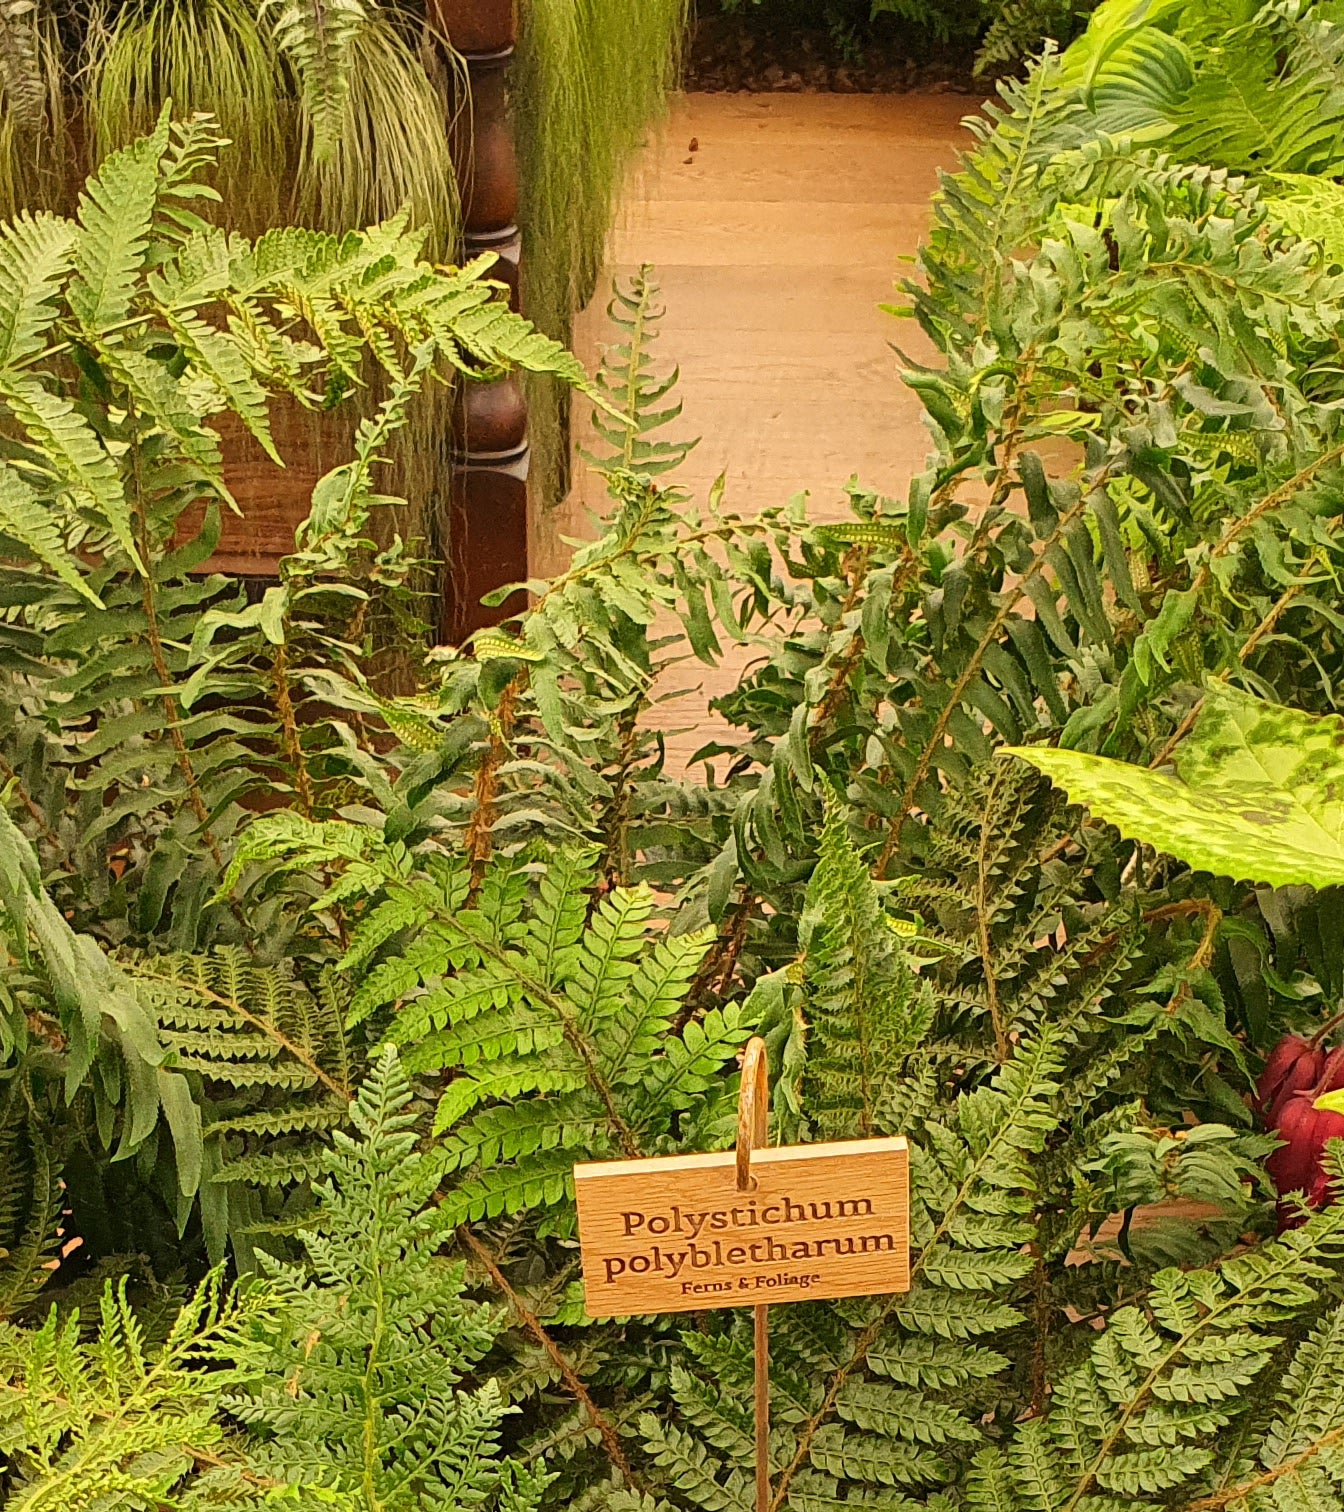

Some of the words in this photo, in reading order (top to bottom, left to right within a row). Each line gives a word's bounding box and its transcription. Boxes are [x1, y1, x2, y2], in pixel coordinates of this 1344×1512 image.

[620, 1197, 875, 1240] Polystichum
[603, 1232, 896, 1284] polybletharum
[681, 1280, 733, 1295] Ferns
[738, 1277, 749, 1290] &
[755, 1272, 821, 1289] Foliage
